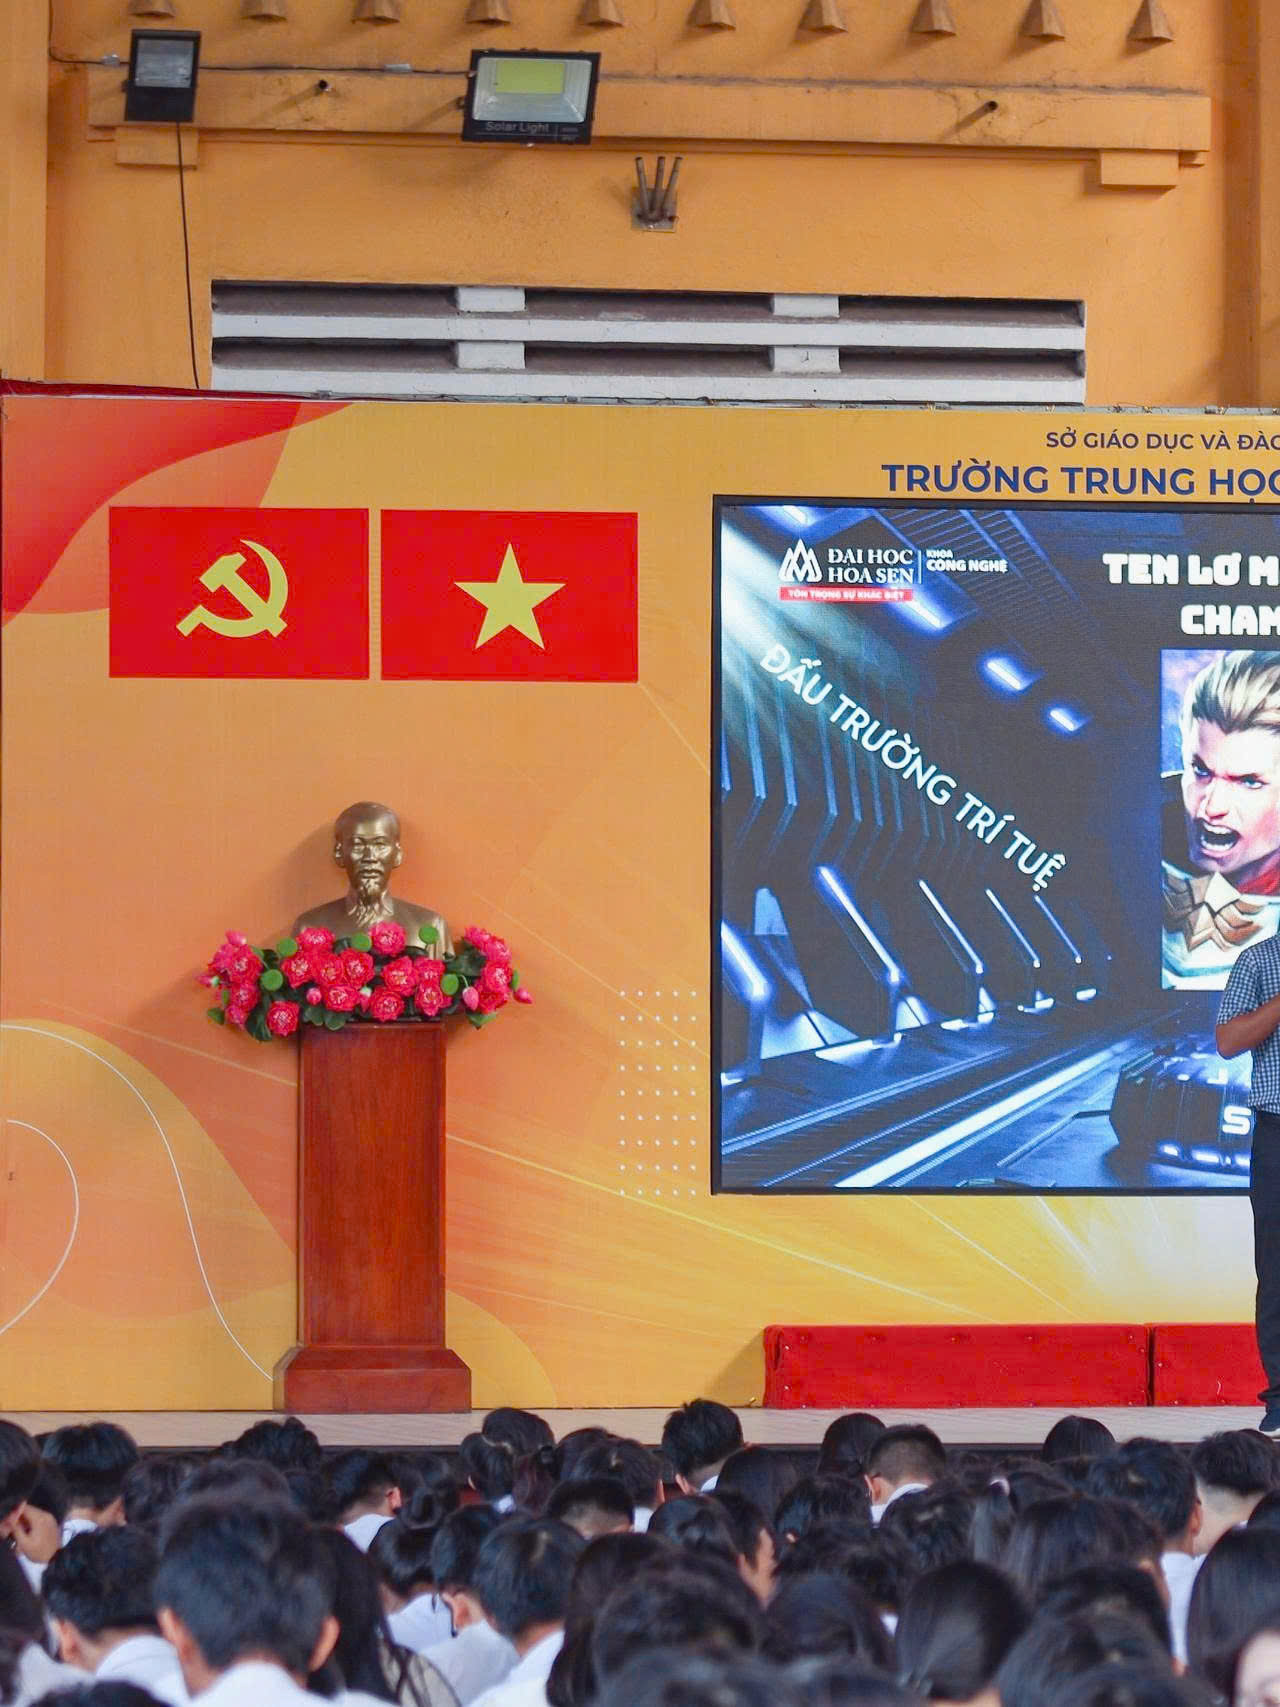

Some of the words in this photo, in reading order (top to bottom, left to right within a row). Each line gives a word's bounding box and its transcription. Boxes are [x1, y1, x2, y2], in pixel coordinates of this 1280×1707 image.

[1046, 427, 1077, 449] SỞ
[1084, 428, 1139, 450] GIÁO
[1146, 433, 1194, 454] DỤC
[1201, 430, 1230, 450] VÀ
[881, 458, 1048, 493] TRƯỜNG
[1060, 466, 1195, 495] TRUNG
[828, 548, 863, 567] ĐẠI
[868, 548, 913, 567] HỌC
[1102, 552, 1179, 585] TEN
[1187, 551, 1242, 586] LƠ
[828, 567, 873, 584] HOA
[876, 567, 914, 585] SEN
[760, 643, 833, 706] ĐẤU
[830, 694, 957, 806] TRƯỜNG
[955, 792, 1015, 845] TRÍ
[1003, 830, 1067, 892] TUỆ
